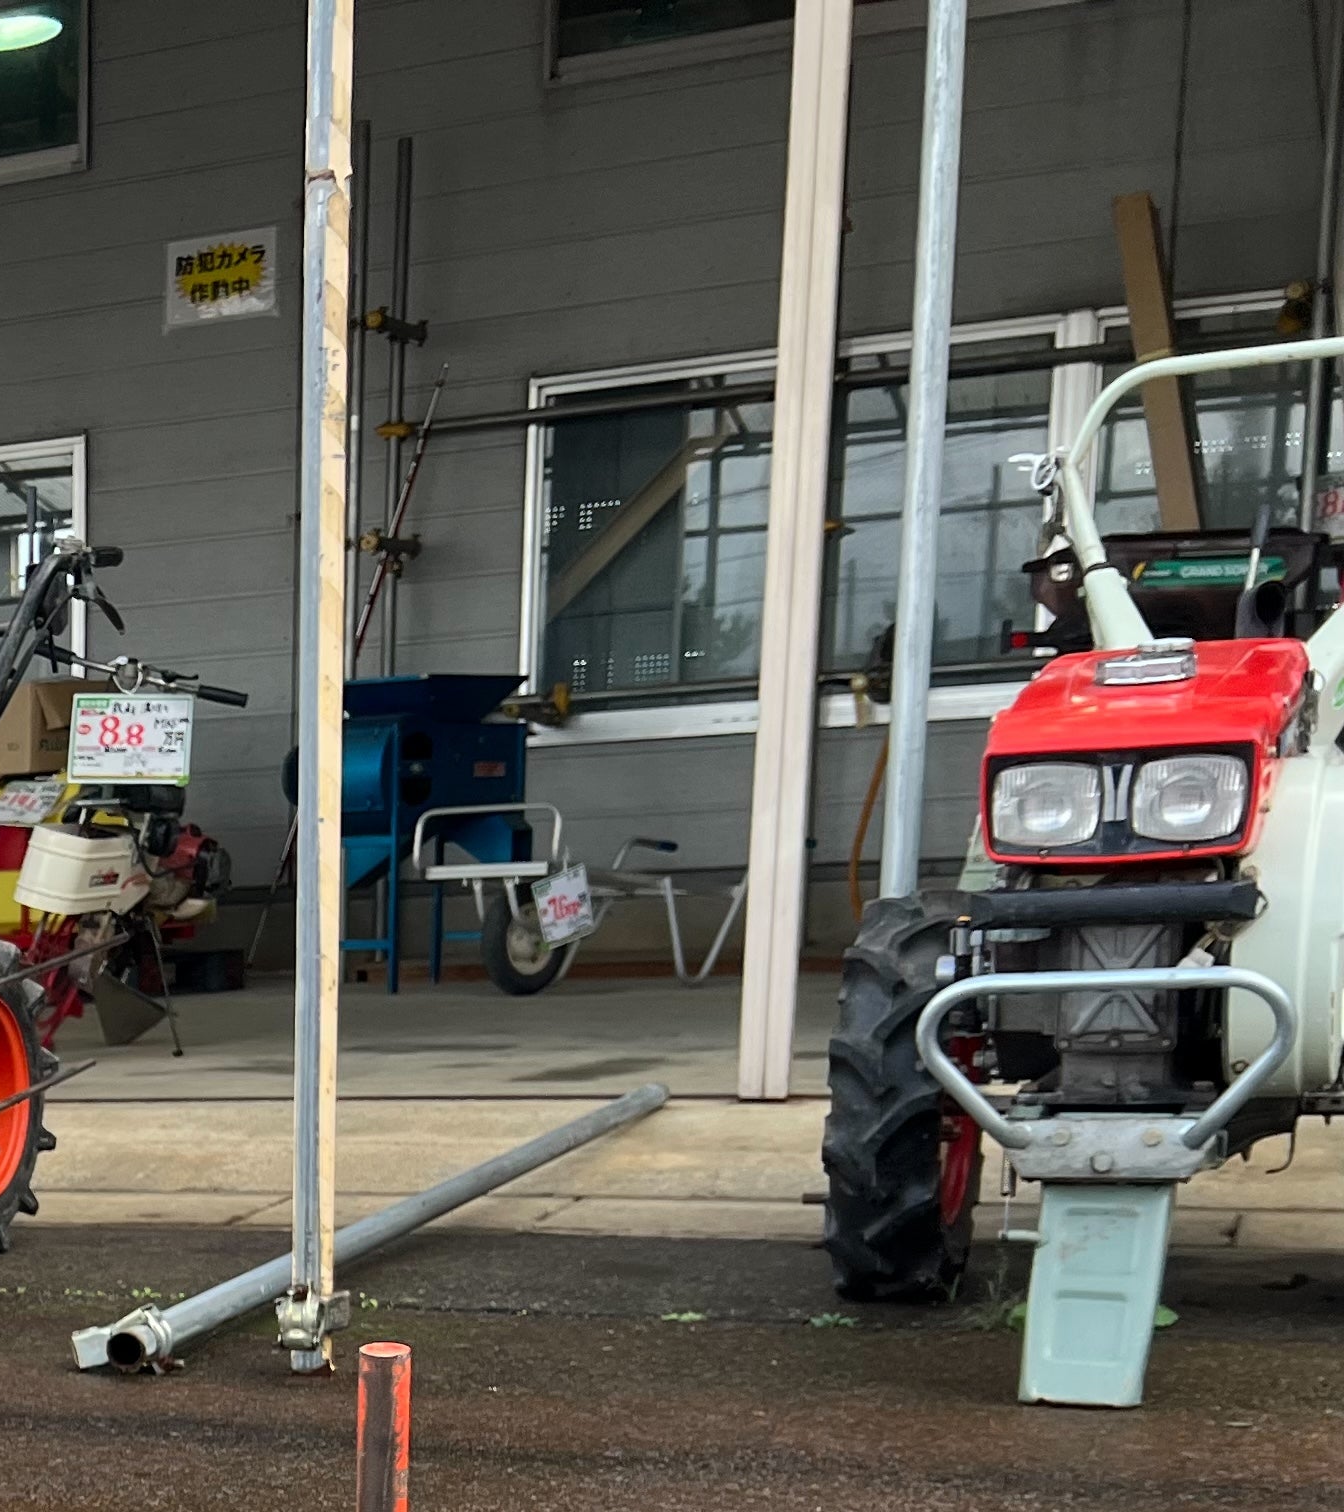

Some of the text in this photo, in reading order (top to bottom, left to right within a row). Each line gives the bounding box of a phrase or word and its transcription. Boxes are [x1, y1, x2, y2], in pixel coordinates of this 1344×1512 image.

[175, 244, 266, 277] 防犯カメラ
[190, 276, 250, 304] 作動中
